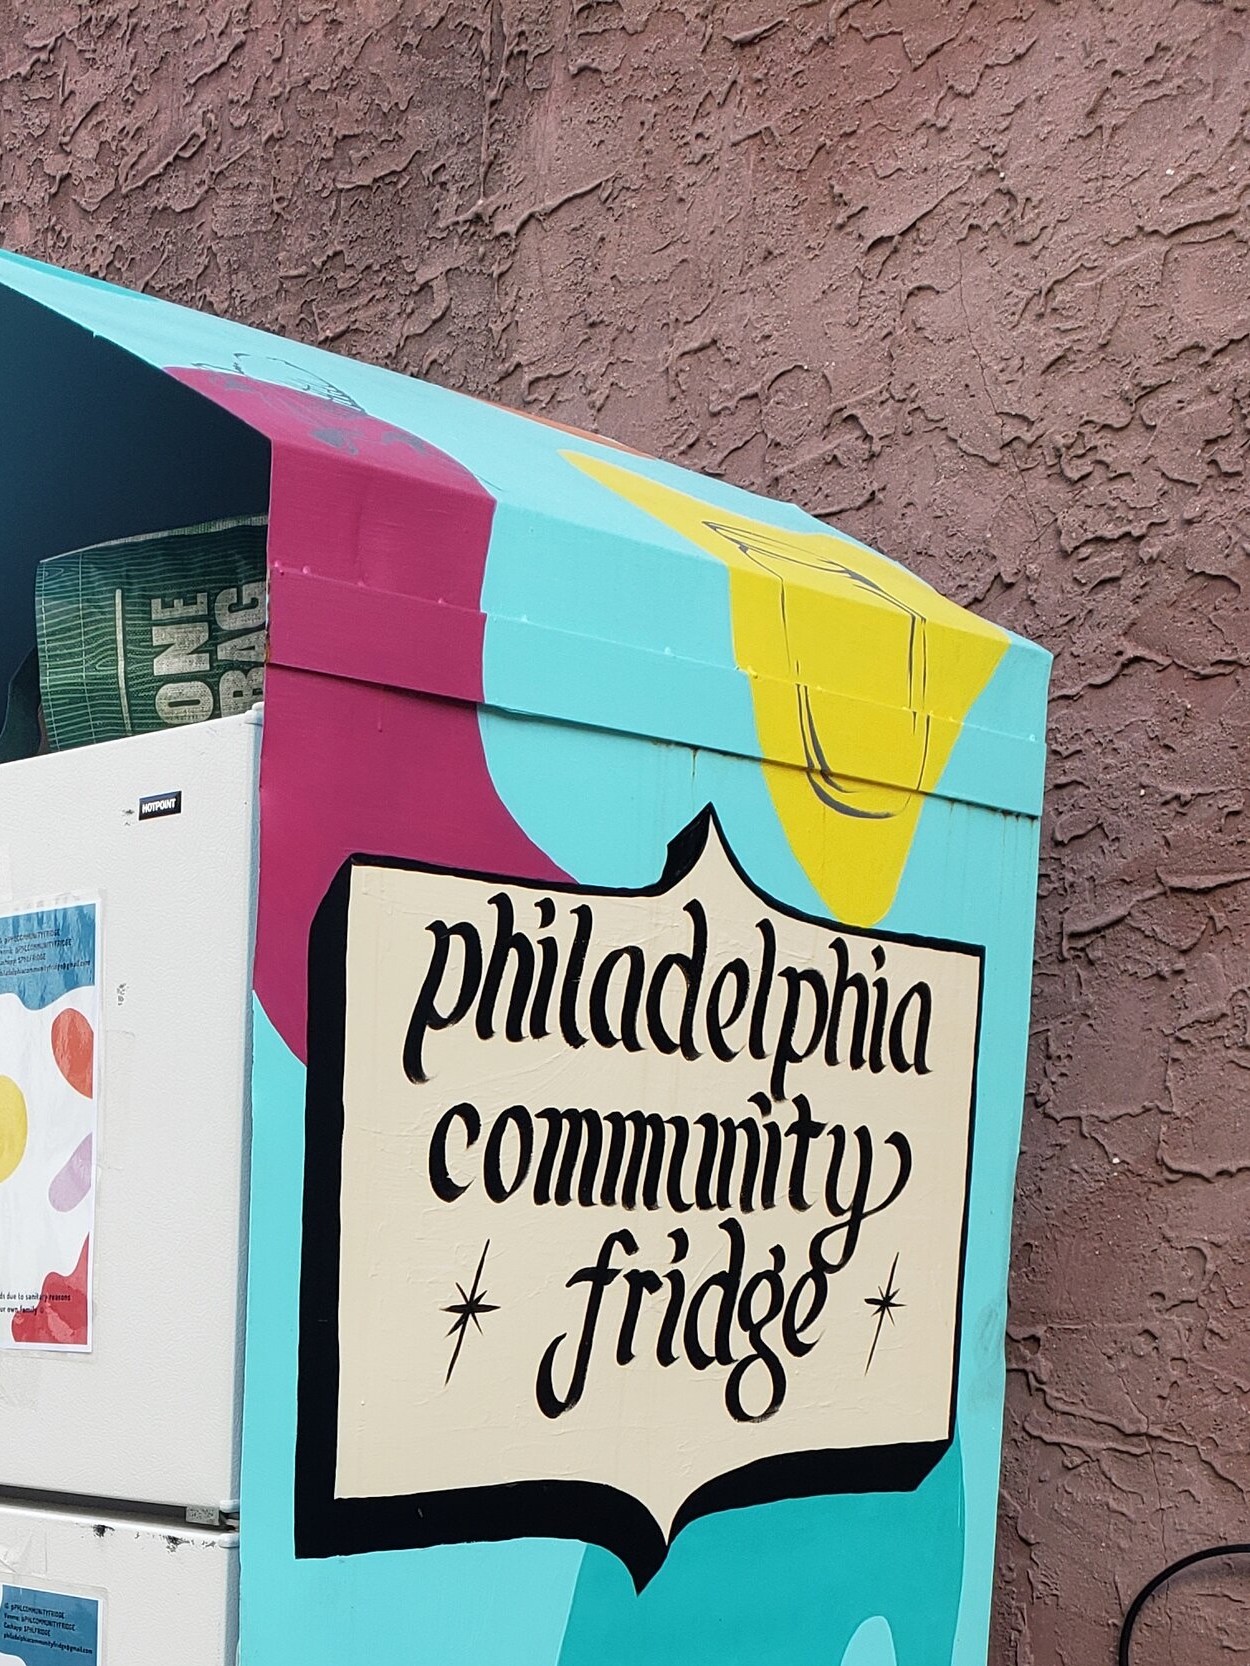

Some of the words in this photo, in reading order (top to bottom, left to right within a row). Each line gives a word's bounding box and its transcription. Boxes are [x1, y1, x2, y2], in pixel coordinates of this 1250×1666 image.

[151, 592, 214, 724] ONE
[214, 581, 265, 718] BAG
[142, 798, 176, 813] HOTPOINT
[402, 892, 932, 1101] philadelphia
[429, 1091, 911, 1274] community
[536, 1218, 835, 1422] fridge
